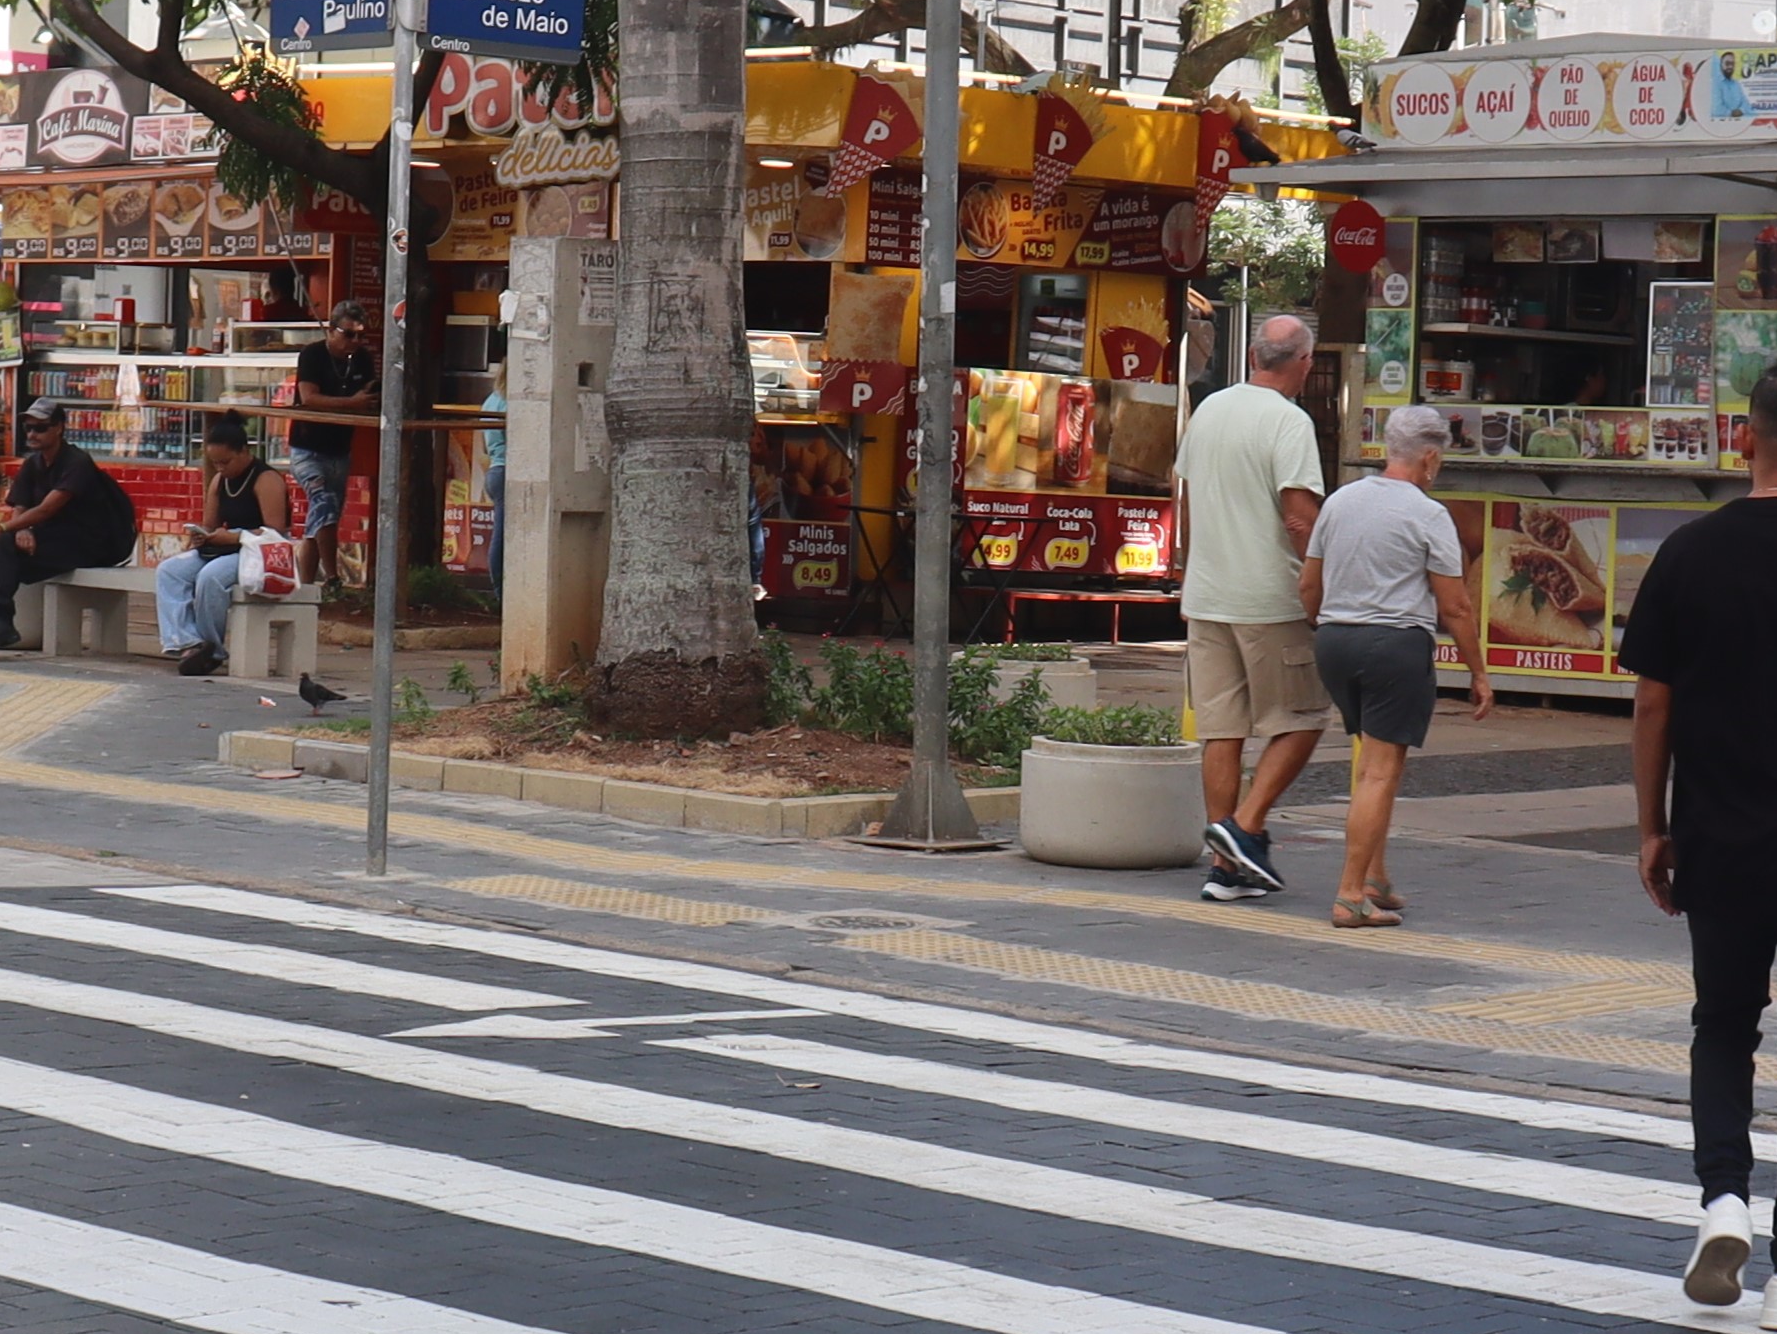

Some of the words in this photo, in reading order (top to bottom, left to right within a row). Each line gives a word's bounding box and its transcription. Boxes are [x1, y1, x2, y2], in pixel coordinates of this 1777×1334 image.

[481, 6, 509, 28] de
[516, 7, 569, 35] Maio
[281, 36, 312, 52] Centro
[430, 34, 471, 53] Centro
[1560, 63, 1584, 85] PÃO
[1631, 60, 1667, 83] ÁGUA
[1396, 91, 1450, 117] SUCOS
[1475, 84, 1515, 119] AÇAÍ
[1564, 88, 1579, 106] DE
[1638, 86, 1655, 105] DE
[42, 111, 71, 140] Café
[72, 108, 121, 139] Marina
[1548, 109, 1590, 129] QUEIJO
[1629, 107, 1665, 127] COCO
[747, 175, 801, 208] astel
[872, 182, 895, 194] Mini
[460, 195, 477, 213] de
[482, 187, 518, 208] Feira
[1101, 202, 1110, 217] A
[1111, 198, 1138, 216] vida
[1141, 196, 1150, 213] é
[752, 202, 793, 228] Aqui!
[869, 210, 879, 220] 10
[880, 210, 899, 221] mini
[1043, 212, 1084, 232] Frita
[1093, 219, 1110, 233] um
[1111, 214, 1160, 232] morango
[868, 223, 879, 233] 20
[880, 224, 899, 235] mini
[868, 236, 879, 247] 50
[880, 238, 899, 248] mini
[1023, 241, 1055, 259] 14,99
[867, 250, 883, 261] 100
[884, 251, 902, 262] mini
[1079, 246, 1105, 260] 17,99
[967, 500, 991, 513] Suco
[992, 501, 1029, 515] Natural
[1047, 506, 1093, 520] Coca-Cola
[1118, 507, 1145, 520] Pastel
[1147, 508, 1159, 520] de
[799, 525, 834, 541] Minis
[1059, 520, 1080, 532] Lata
[1127, 520, 1150, 532] Feira
[788, 539, 848, 557] Salgados
[1054, 546, 1080, 562] 7,49
[1124, 551, 1152, 567] 11,99
[801, 566, 832, 582] 8,49
[1516, 650, 1572, 671] PASTEIS
